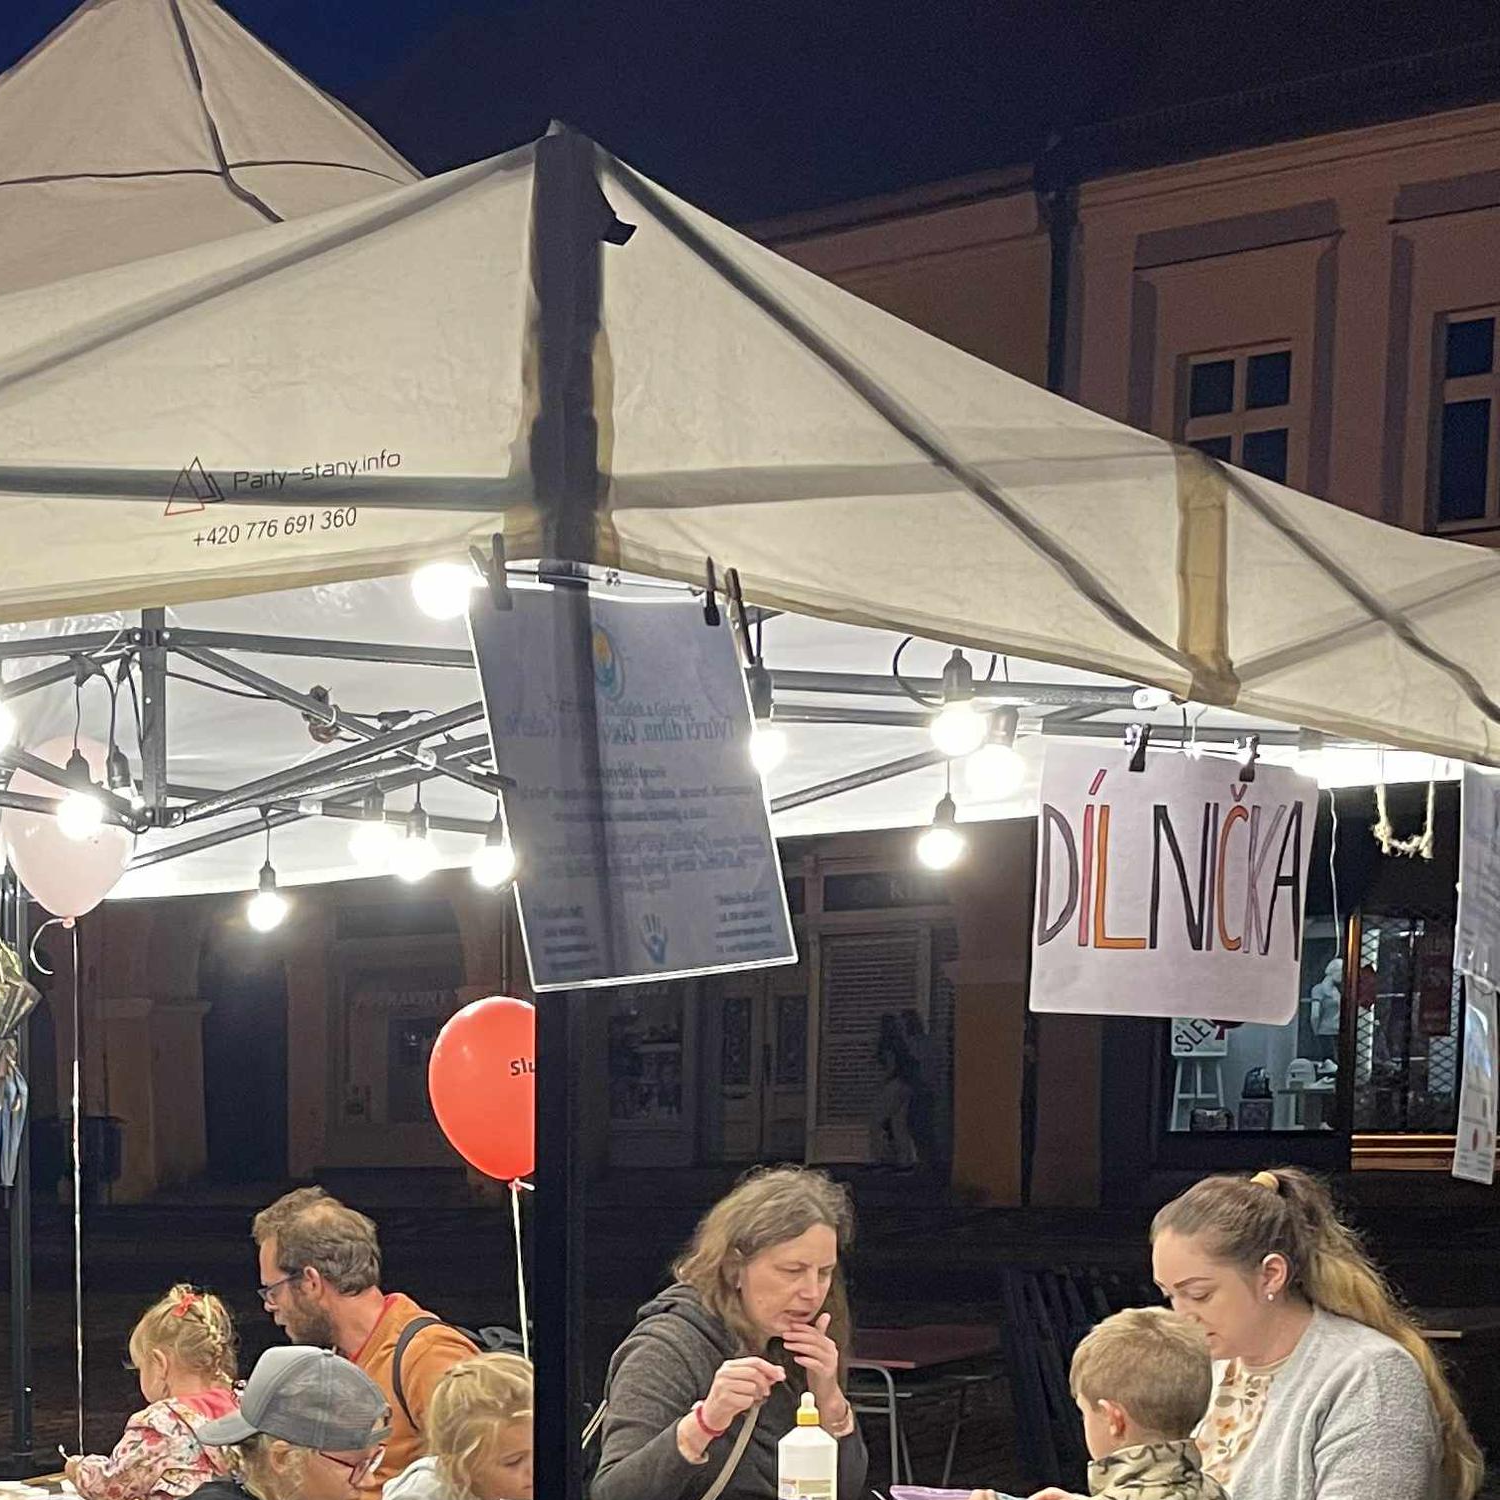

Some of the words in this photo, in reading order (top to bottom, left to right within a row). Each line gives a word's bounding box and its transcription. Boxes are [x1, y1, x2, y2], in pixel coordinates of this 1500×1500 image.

[233, 449, 401, 491] Party-stany.info
[193, 524, 240, 547] +420
[246, 519, 279, 541] 776
[284, 513, 314, 536] 691
[320, 506, 358, 531] 360
[1037, 769, 1304, 962] DÍLNIČKA
